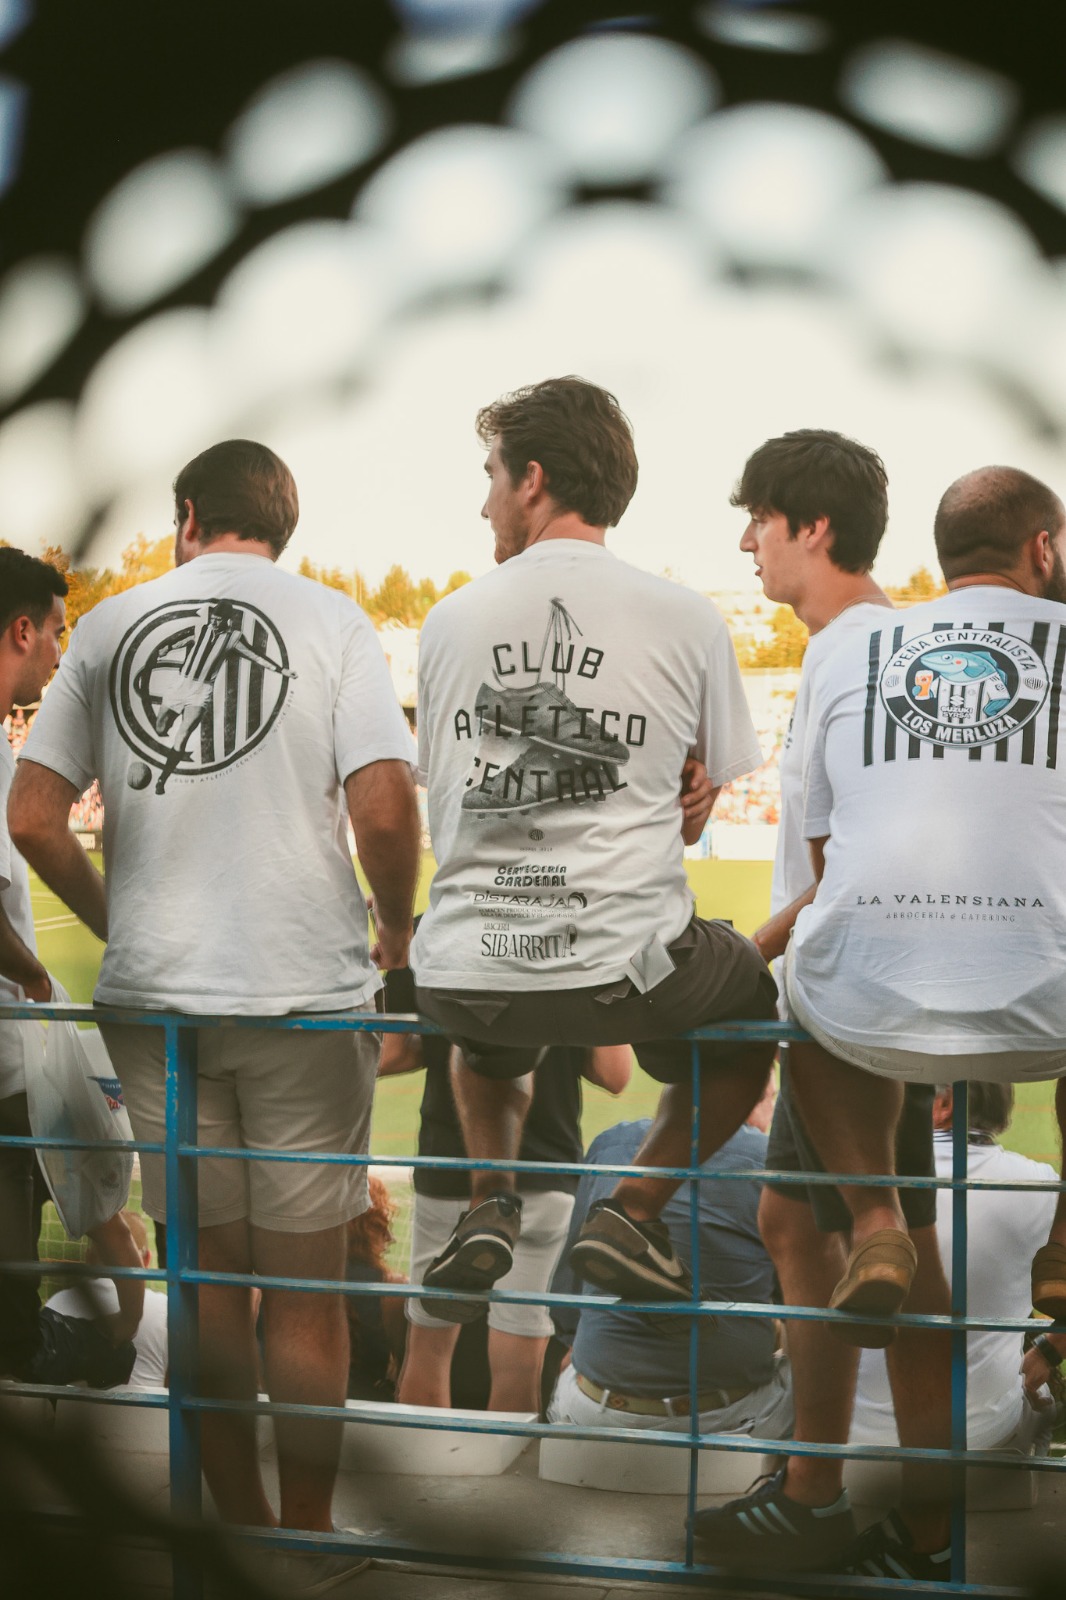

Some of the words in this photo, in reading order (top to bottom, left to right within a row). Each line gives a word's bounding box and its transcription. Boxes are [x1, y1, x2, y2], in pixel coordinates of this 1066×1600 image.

[492, 641, 605, 680] CLUB
[893, 639, 931, 668] PEÑA
[934, 632, 1037, 672] CENTRALISTA
[454, 694, 647, 747] ATLÉTICO
[901, 709, 933, 736] LOS
[935, 714, 1019, 744] MERLUZA
[494, 874, 567, 888] CARDENAL
[857, 895, 882, 905] LA
[894, 894, 1044, 908] VALENSIANA
